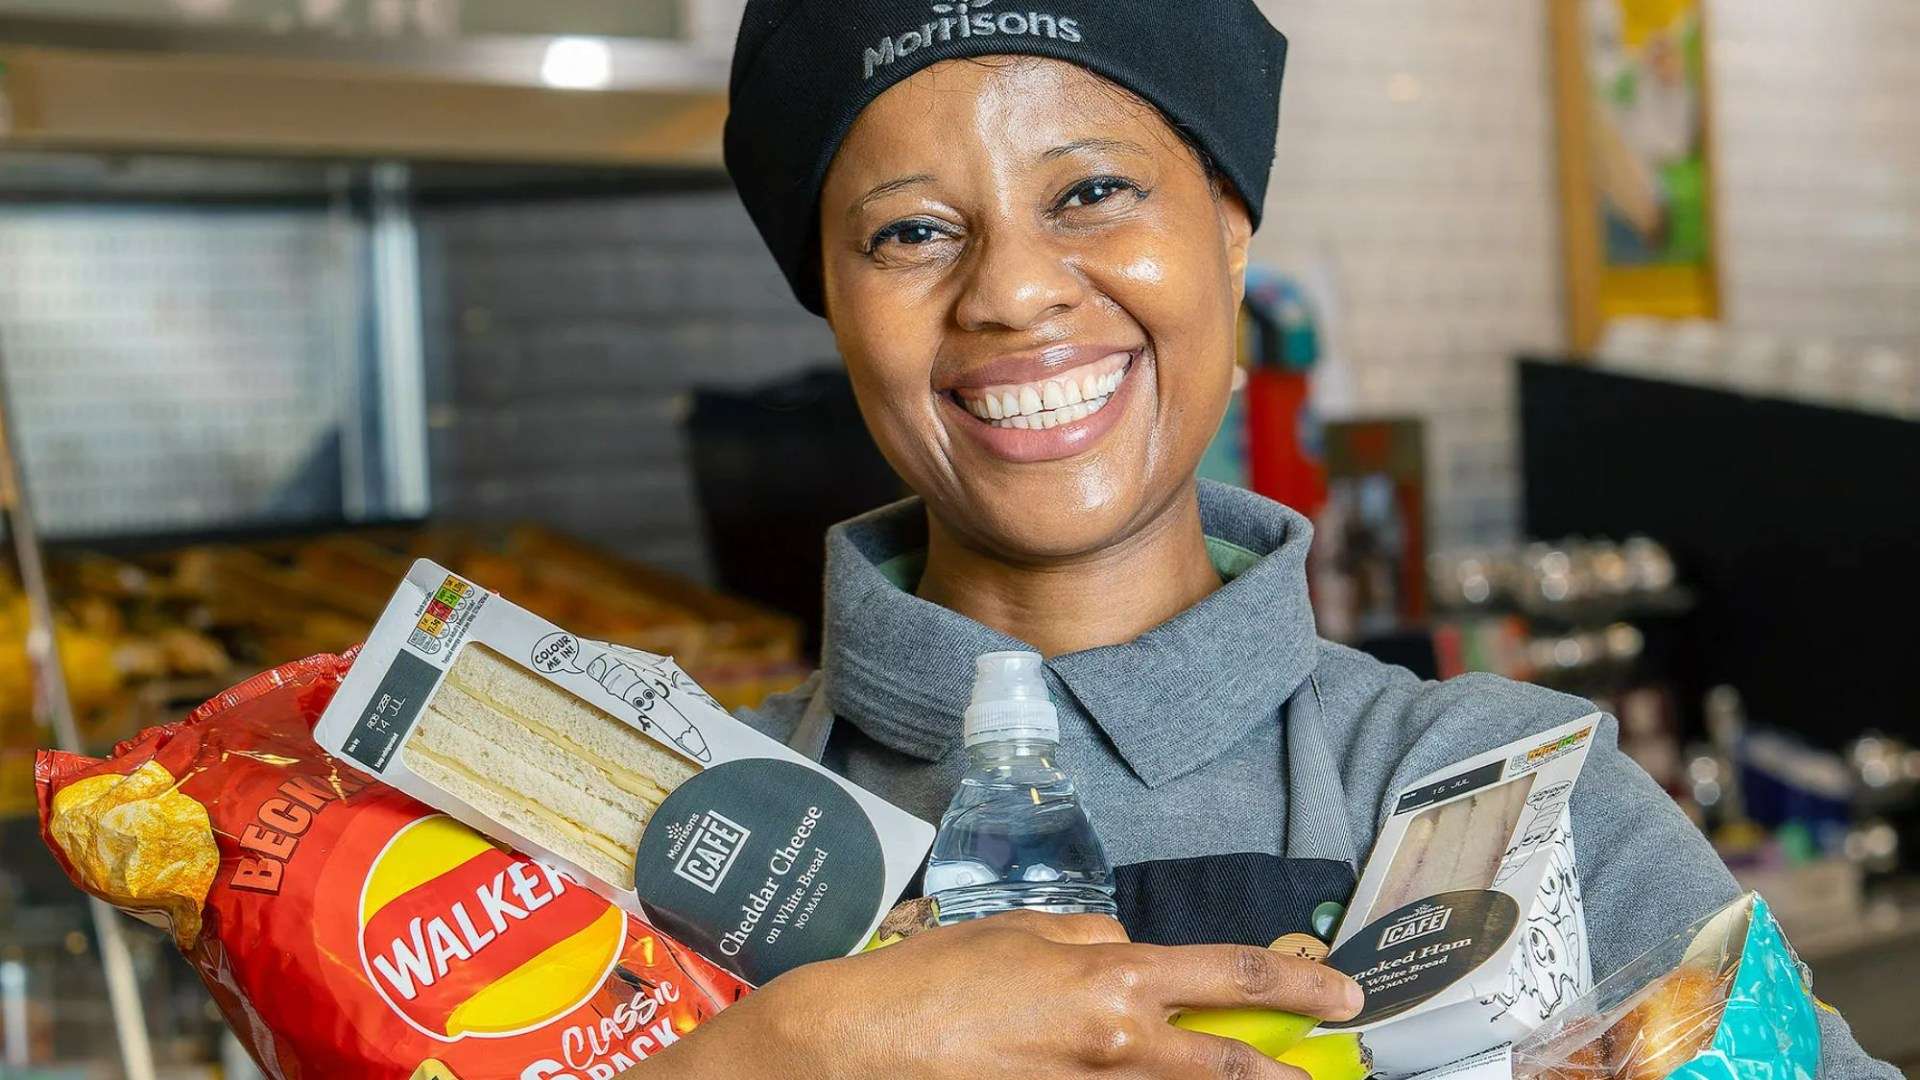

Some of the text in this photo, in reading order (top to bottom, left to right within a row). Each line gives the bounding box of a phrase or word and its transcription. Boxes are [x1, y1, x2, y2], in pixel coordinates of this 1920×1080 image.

[863, 12, 1082, 79] Morrisons
[534, 635, 571, 664] COLOUR
[547, 647, 576, 670] ME IN!
[376, 697, 406, 735] 14 JUL
[667, 812, 699, 861] Morrisons
[719, 805, 823, 957] Cheddar Cheese
[766, 847, 829, 945] on White Bread
[794, 882, 828, 930] NO MAYO
[373, 859, 576, 1000] WALKER
[1351, 938, 1472, 982] moked Ham
[1368, 955, 1448, 988] White Bread
[1369, 974, 1419, 995] NO MAYO
